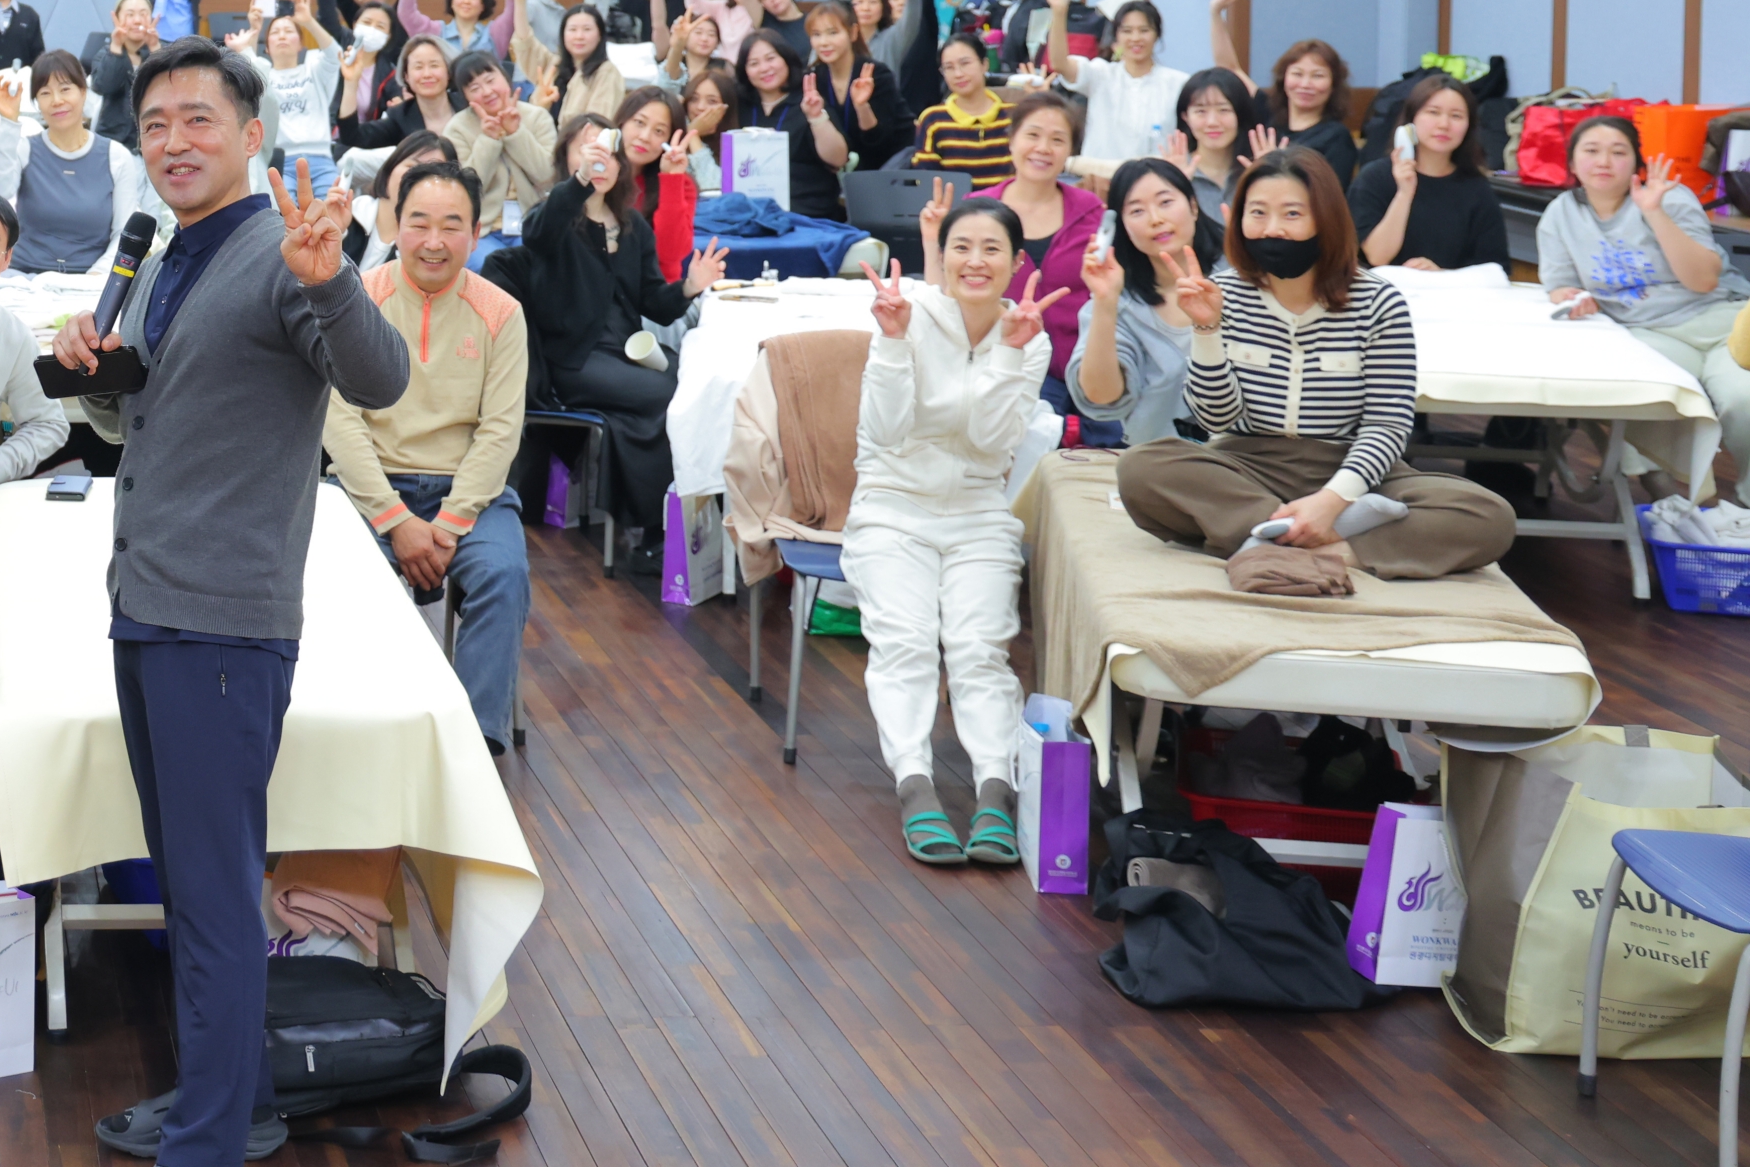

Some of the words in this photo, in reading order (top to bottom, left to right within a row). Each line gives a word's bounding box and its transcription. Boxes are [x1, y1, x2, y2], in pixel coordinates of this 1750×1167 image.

[1630, 921, 1662, 934] means
[1666, 927, 1677, 937] to
[1681, 929, 1695, 938] be
[1623, 942, 1710, 969] yourself
[1617, 1009, 1636, 1017] need
